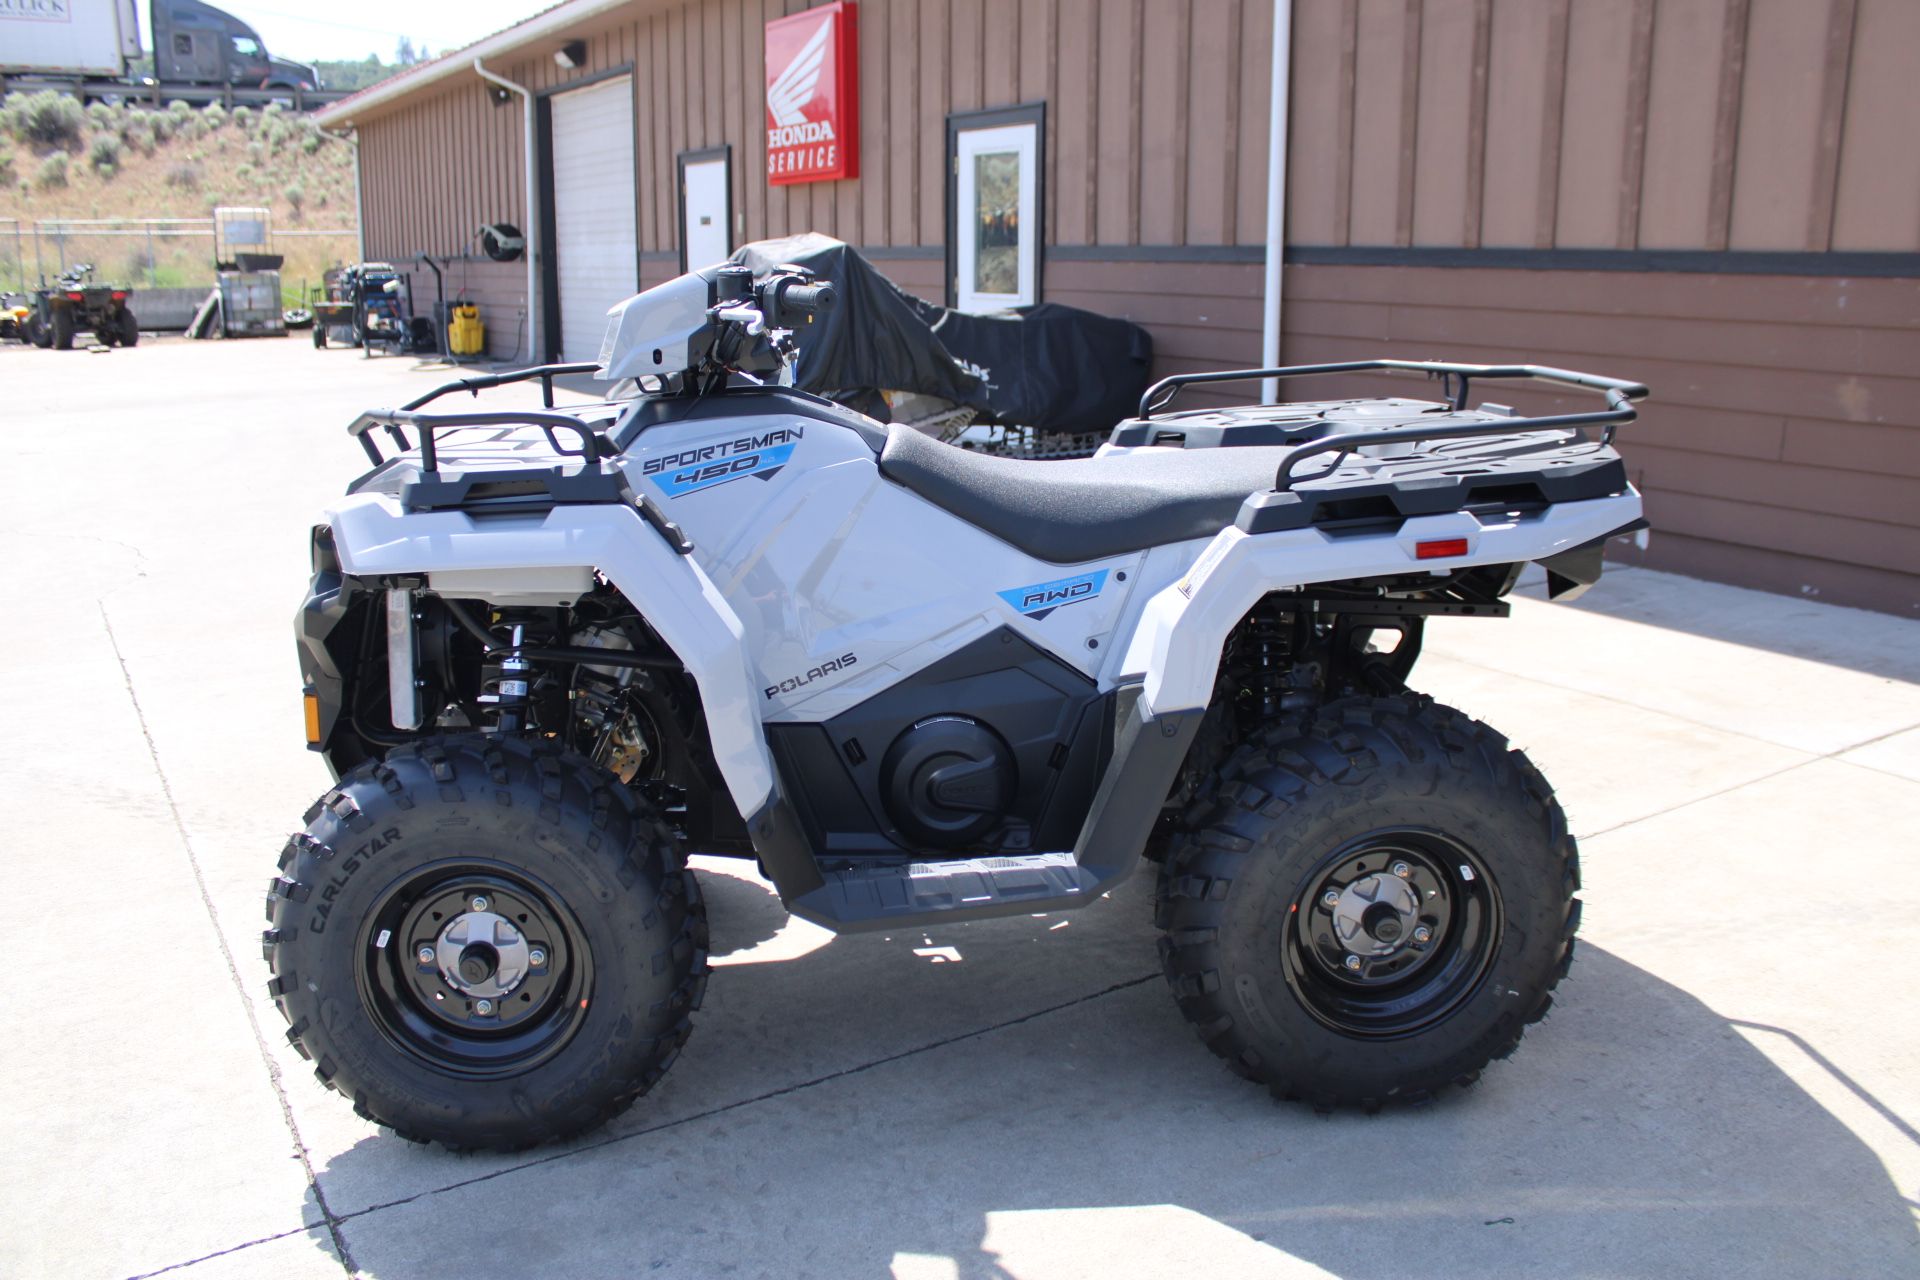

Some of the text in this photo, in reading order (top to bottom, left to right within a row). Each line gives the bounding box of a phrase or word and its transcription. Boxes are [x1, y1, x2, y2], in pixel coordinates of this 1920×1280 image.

[768, 120, 835, 149] HONDA
[768, 145, 836, 174] SERVICE
[643, 427, 804, 475] SPORTSMAN
[674, 455, 760, 484] 450
[1023, 582, 1093, 607] AWD
[764, 652, 857, 700] POLARIS
[310, 827, 403, 935] CARLSTAR
